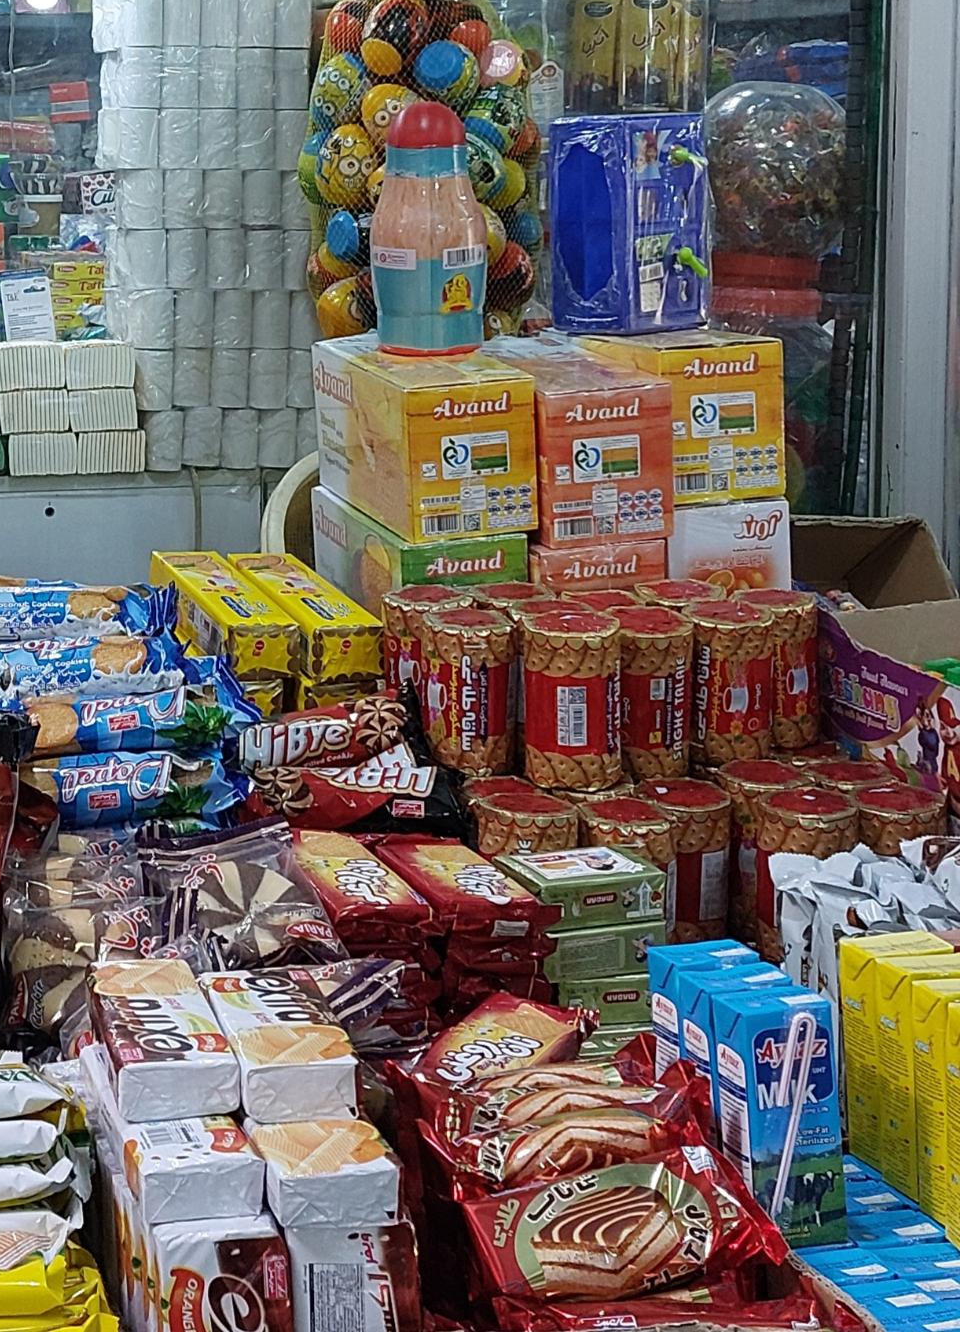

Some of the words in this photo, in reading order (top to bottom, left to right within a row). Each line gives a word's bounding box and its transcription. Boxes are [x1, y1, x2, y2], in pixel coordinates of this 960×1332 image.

[683, 353, 757, 379] Avand
[313, 361, 353, 405] Avand
[432, 391, 510, 420] Avand
[565, 397, 641, 424] Avand
[732, 508, 784, 541] آوند
[426, 550, 502, 578] Avand
[563, 554, 637, 579] Avand
[31, 601, 64, 609] Cookies
[54, 658, 89, 668] Cookies
[673, 655, 685, 707] TALAIE
[672, 709, 684, 761] SAGHE
[294, 923, 333, 940] PARIA
